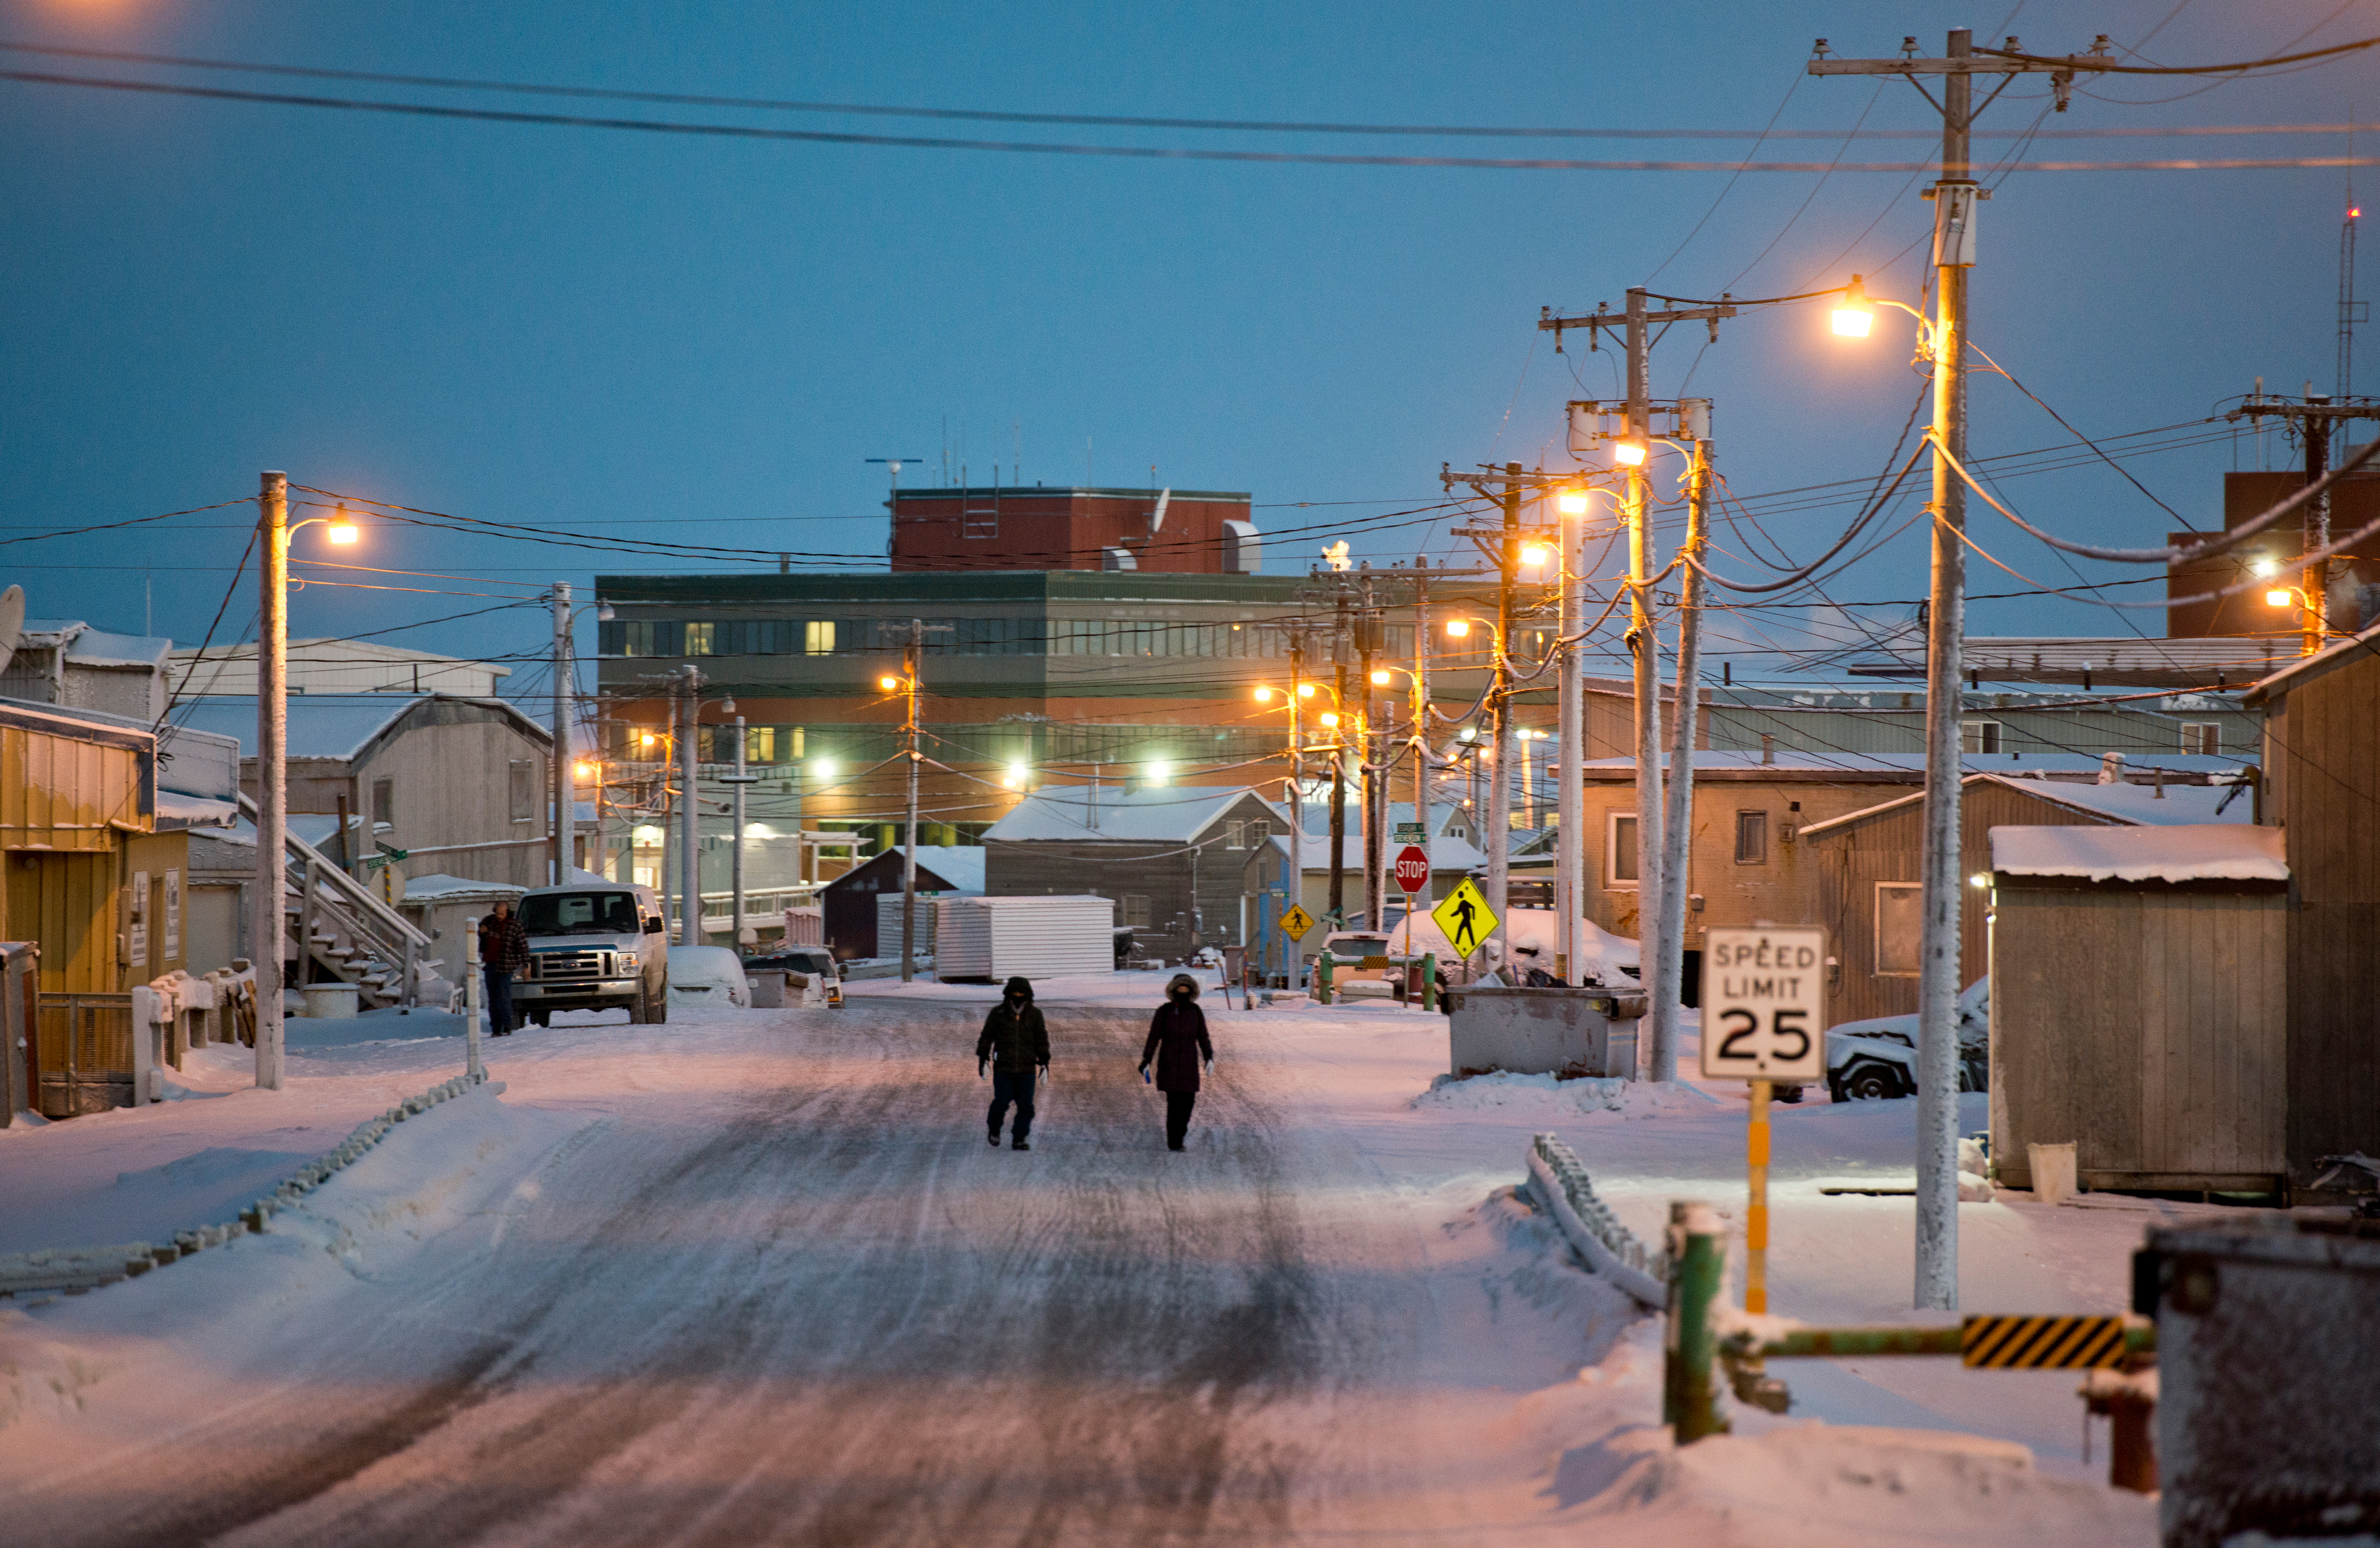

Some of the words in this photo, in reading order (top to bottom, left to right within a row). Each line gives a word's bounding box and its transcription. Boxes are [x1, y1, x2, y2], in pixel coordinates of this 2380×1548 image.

[1397, 860, 1427, 878] STOP
[1715, 944, 1815, 968] SPEED
[1724, 977, 1800, 999] LIMIT
[1718, 1008, 1811, 1061] 25
